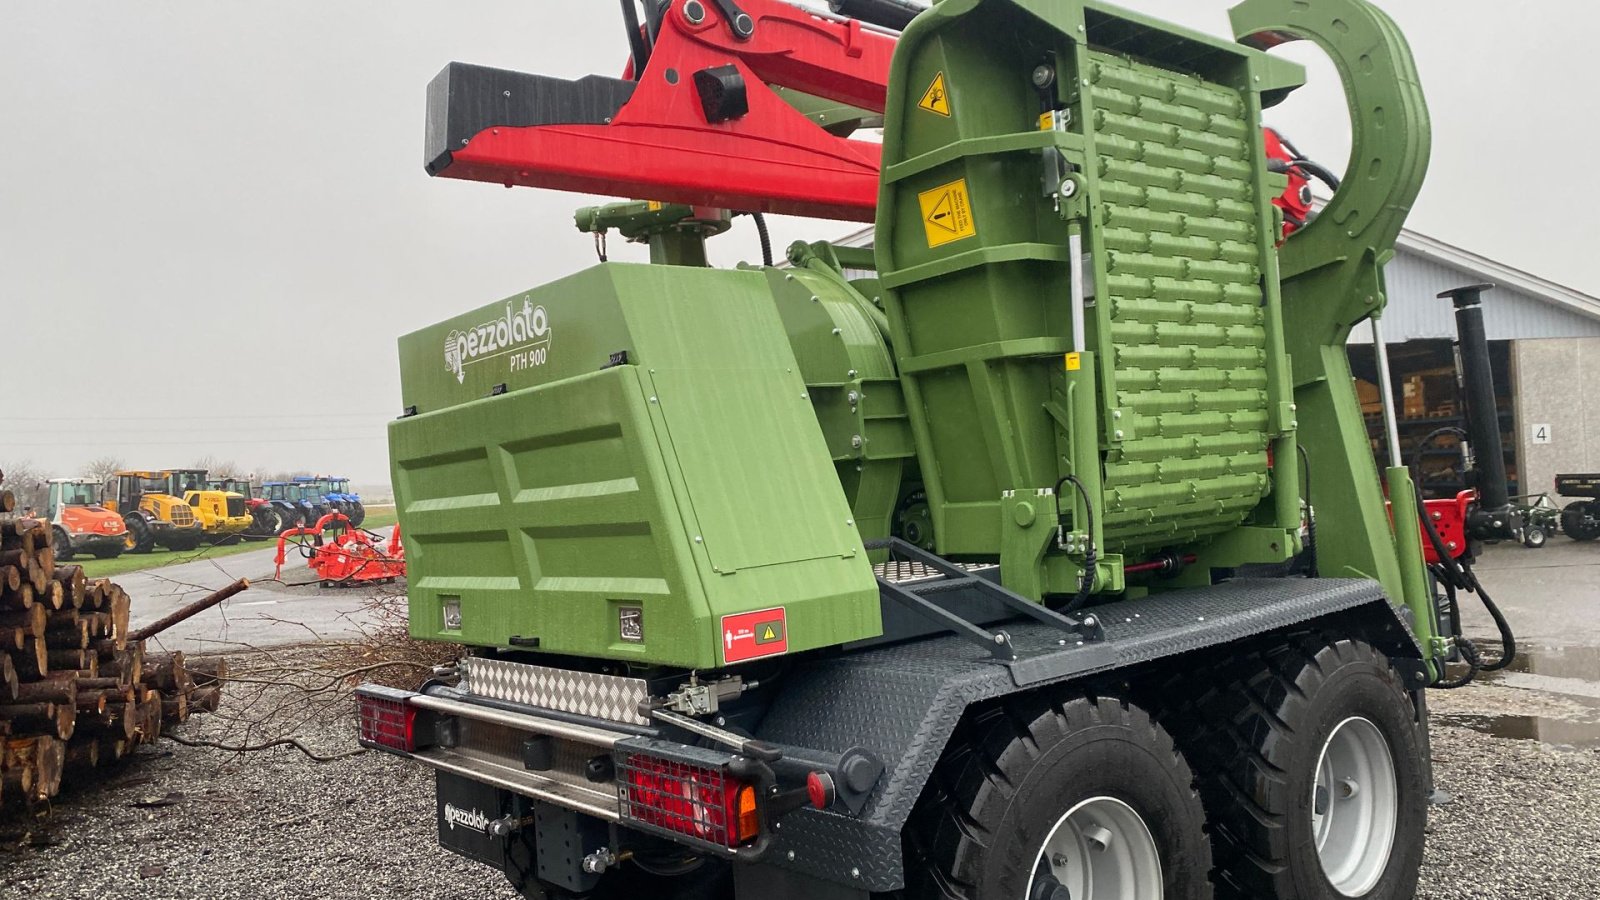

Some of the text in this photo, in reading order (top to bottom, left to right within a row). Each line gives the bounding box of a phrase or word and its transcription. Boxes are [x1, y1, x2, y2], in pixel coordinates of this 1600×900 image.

[456, 294, 549, 384] pezzolato
[510, 347, 547, 372] PTH 900
[1536, 426, 1548, 441] 4
